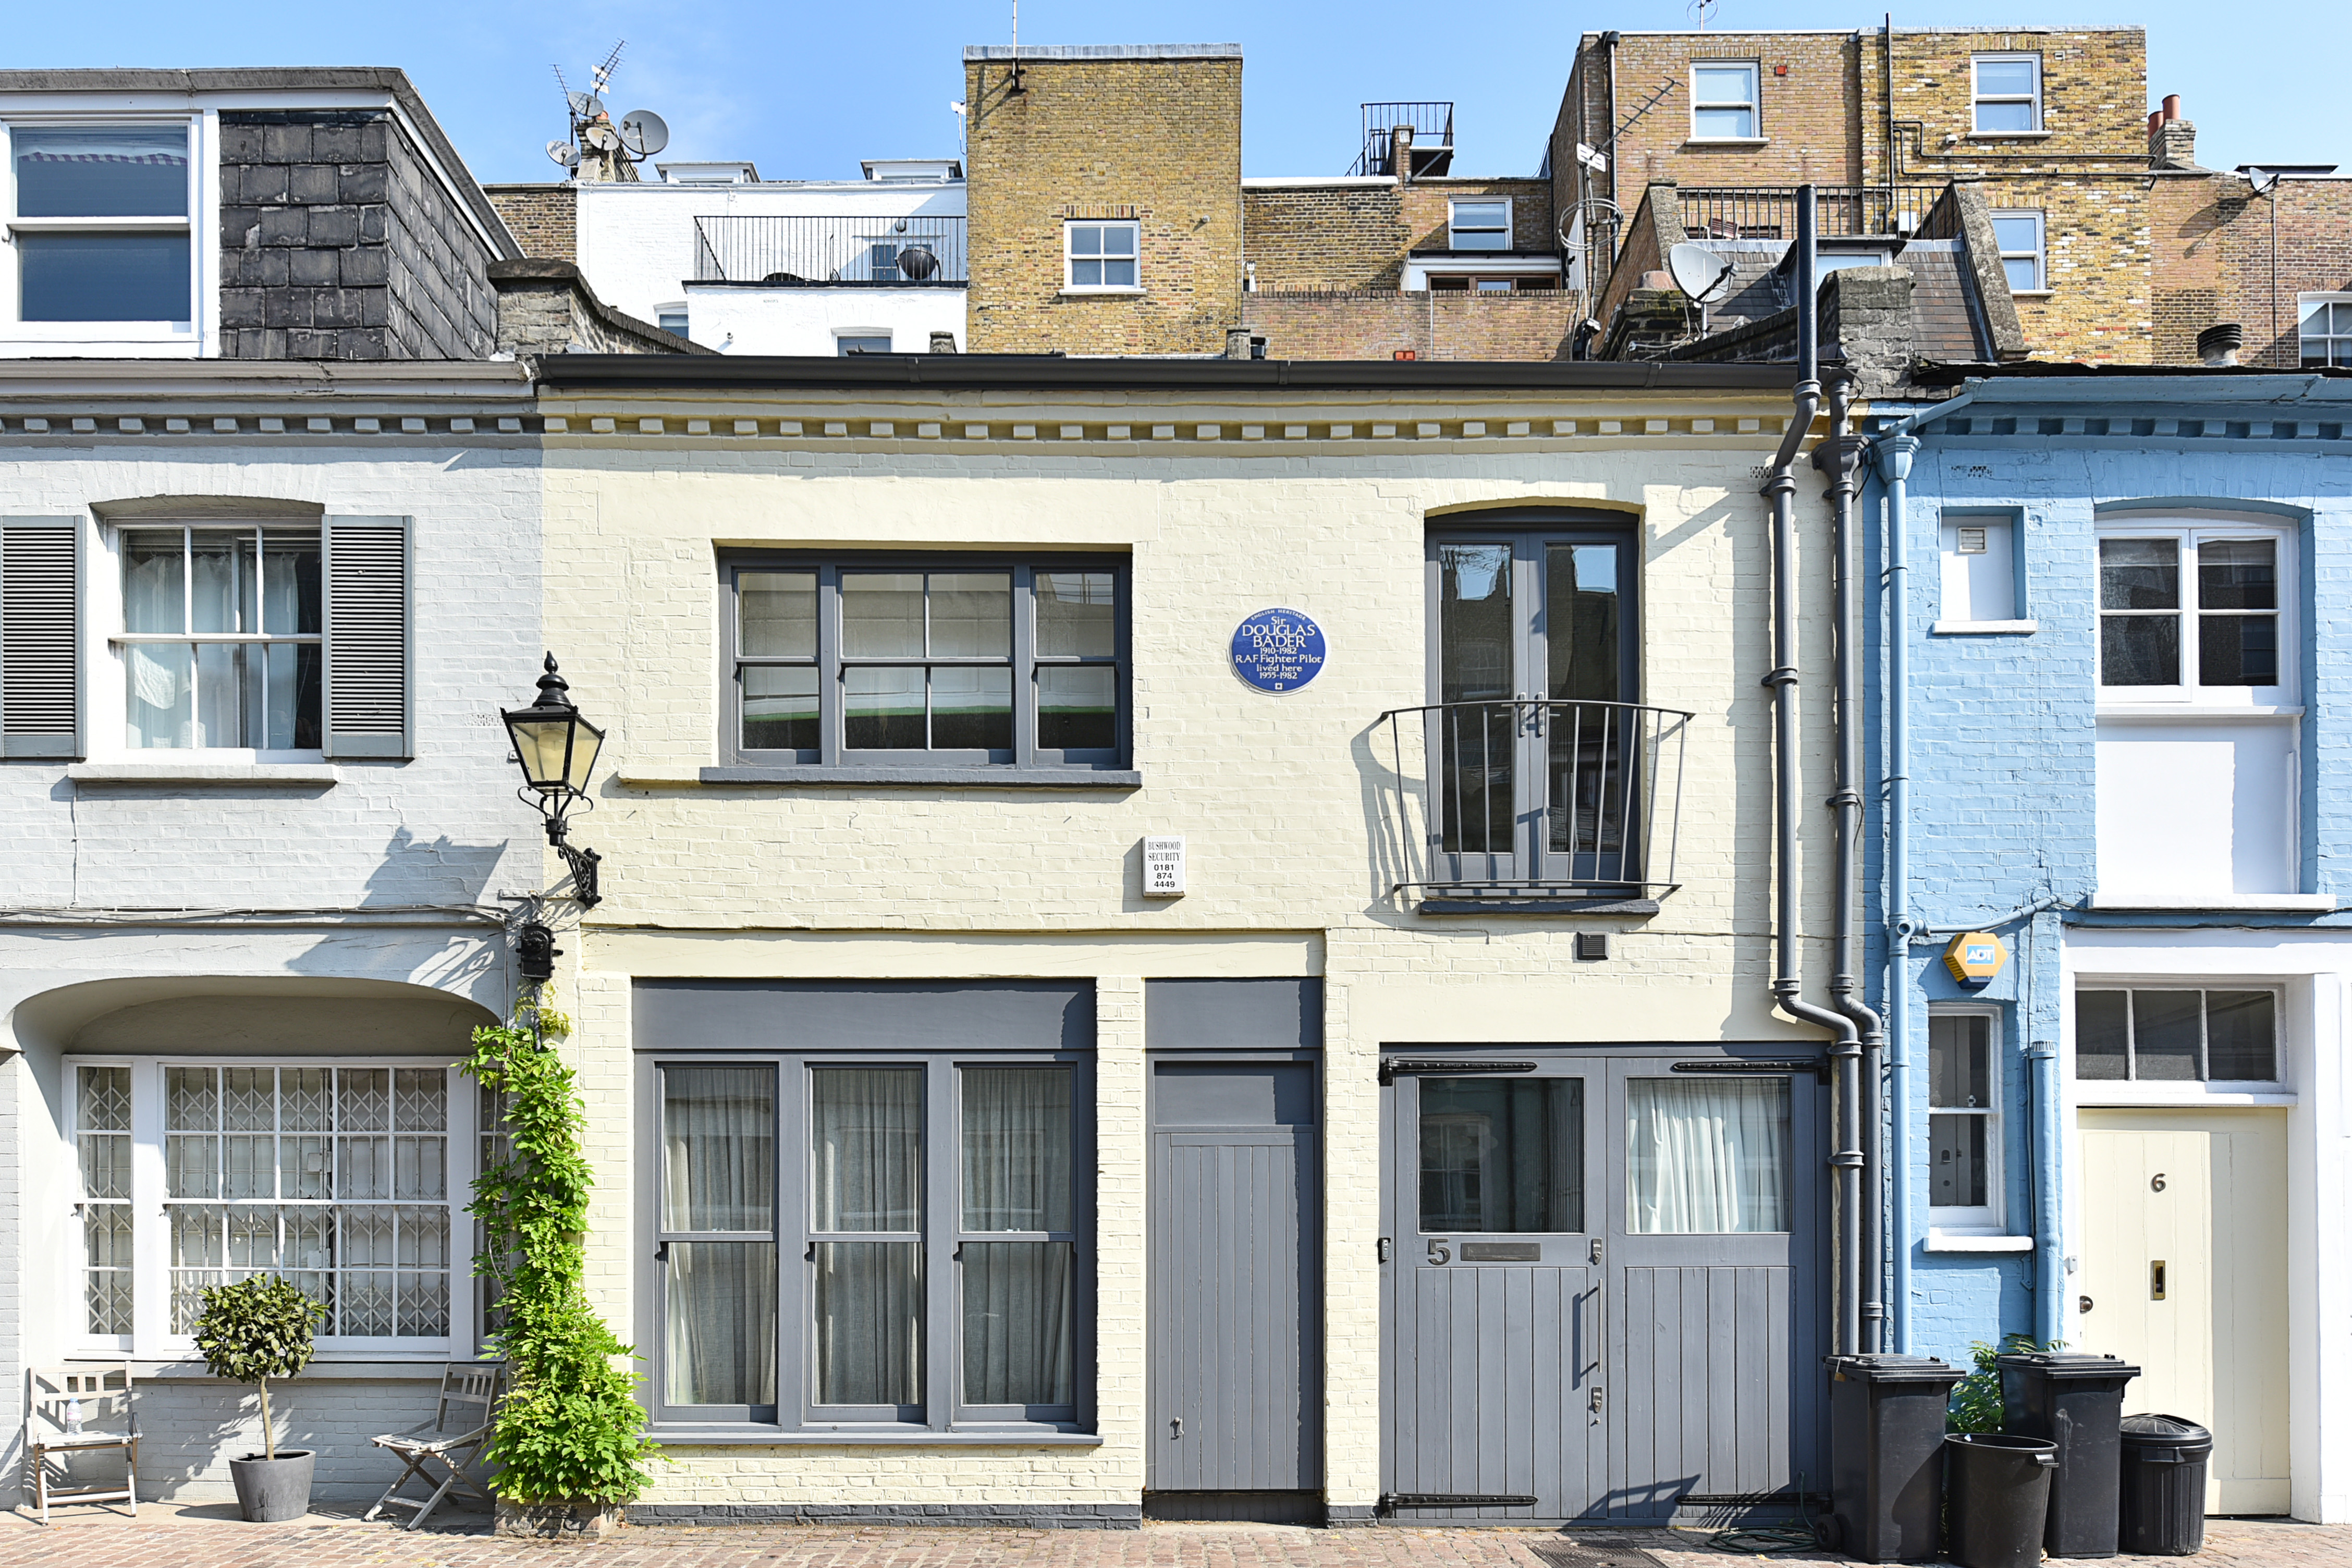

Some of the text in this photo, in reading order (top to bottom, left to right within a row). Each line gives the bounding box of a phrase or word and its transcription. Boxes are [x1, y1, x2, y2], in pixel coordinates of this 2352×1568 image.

[1251, 609, 1307, 621] ENGLISH HERITAGE
[1271, 616, 1287, 625] Sir
[1242, 624, 1316, 636] DOUGLAS
[1253, 635, 1307, 647] BADER
[1235, 654, 1322, 666] RAF Fighter Pilot
[1148, 841, 1181, 850] BUSHWOOD
[1148, 852, 1181, 861] SECURITY
[1967, 949, 1993, 961] ADT
[2151, 1173, 2166, 1193] 6
[1427, 1238, 1451, 1265] 5
